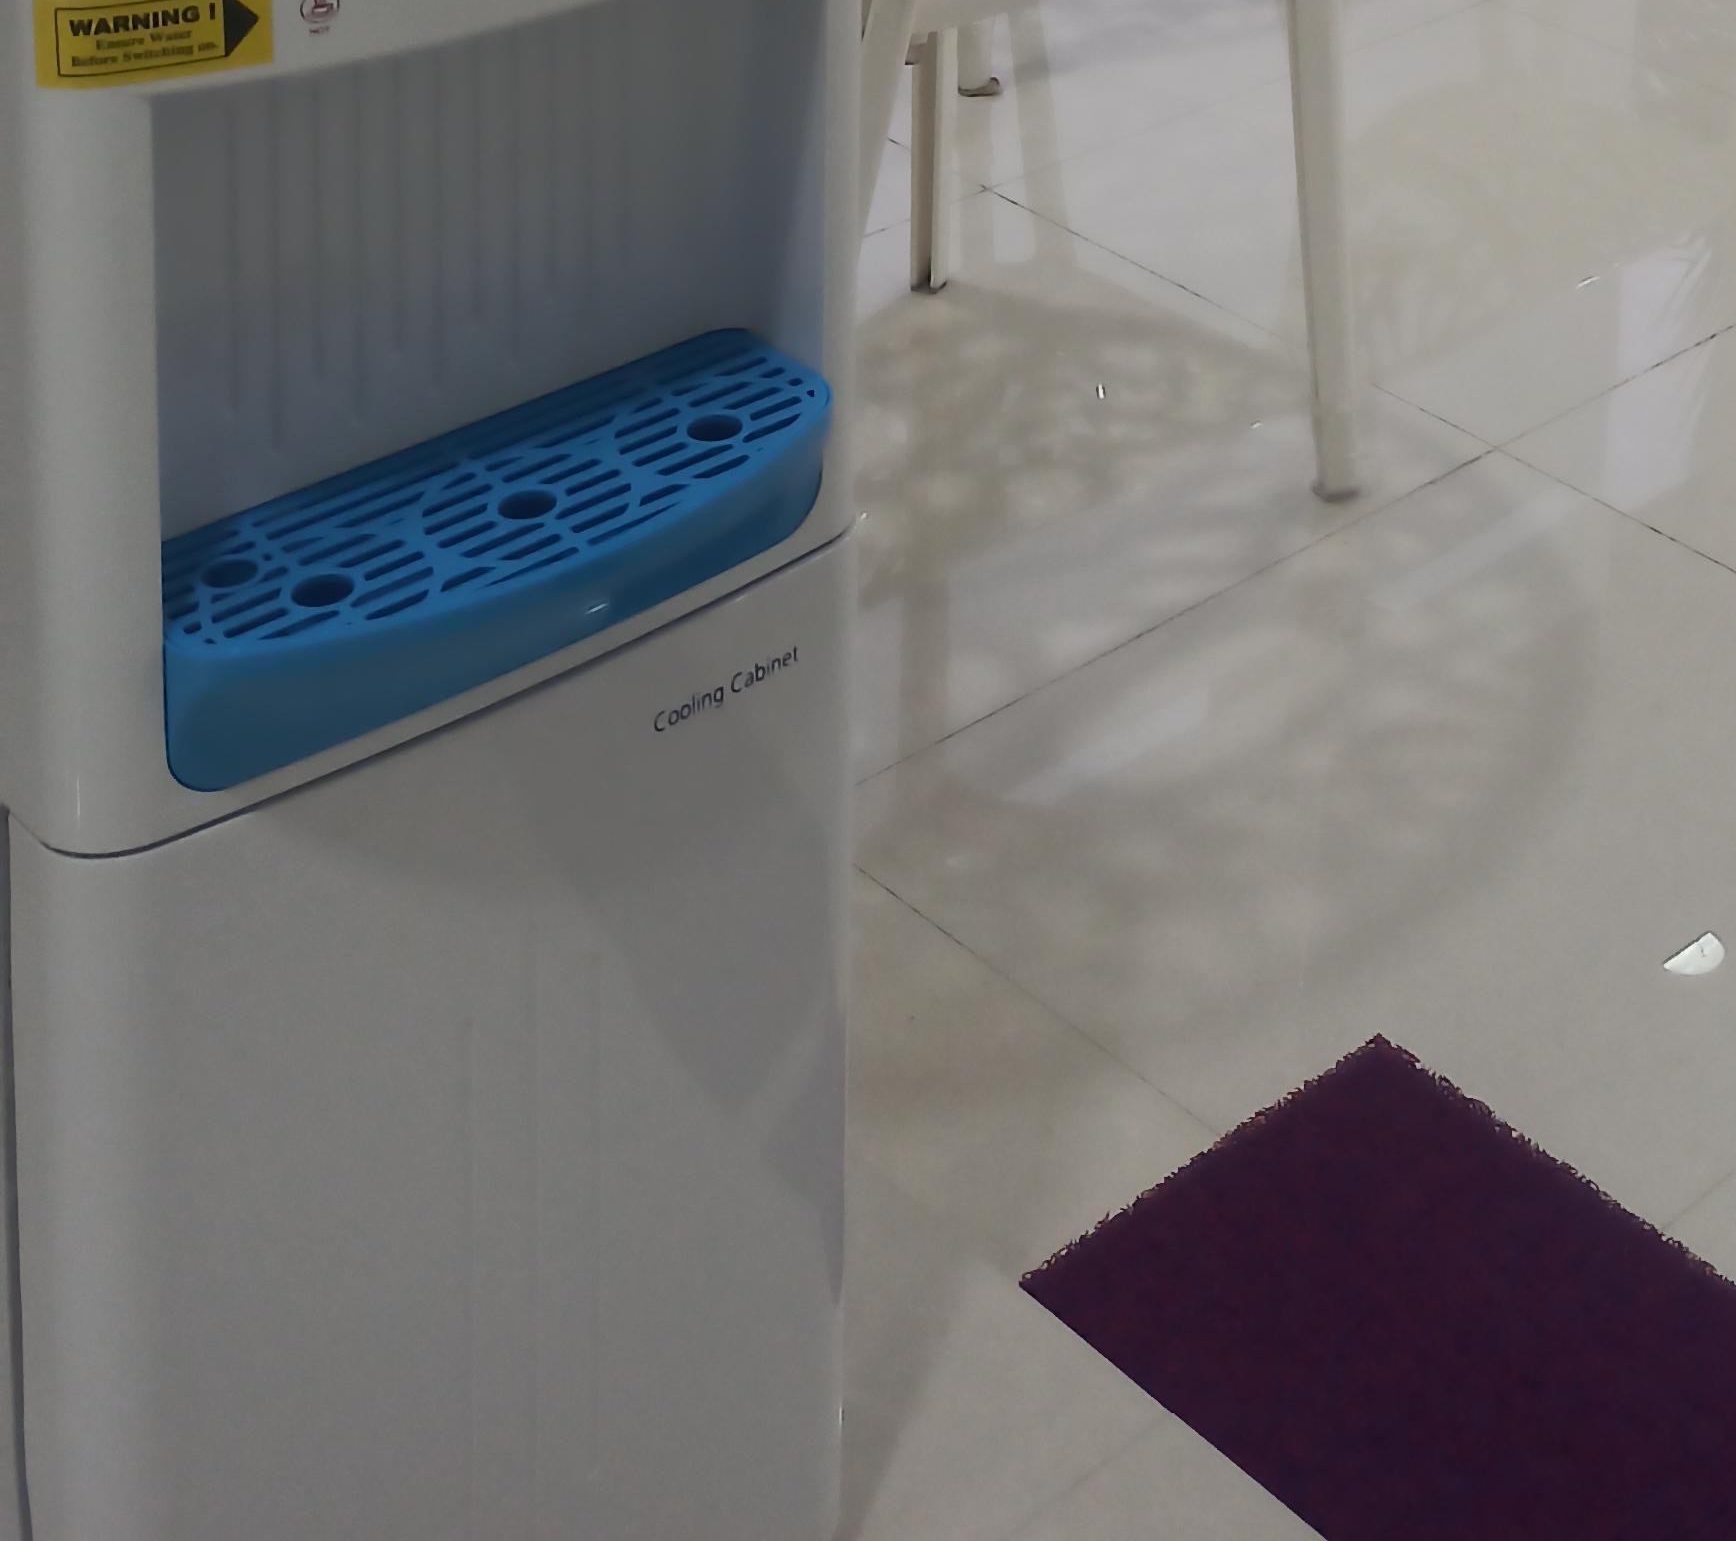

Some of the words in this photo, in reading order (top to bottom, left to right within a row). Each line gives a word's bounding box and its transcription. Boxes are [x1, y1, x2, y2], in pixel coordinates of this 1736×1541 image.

[69, 5, 200, 36] WARNING
[653, 686, 724, 732] Cooling
[730, 645, 799, 693] Cabinet
